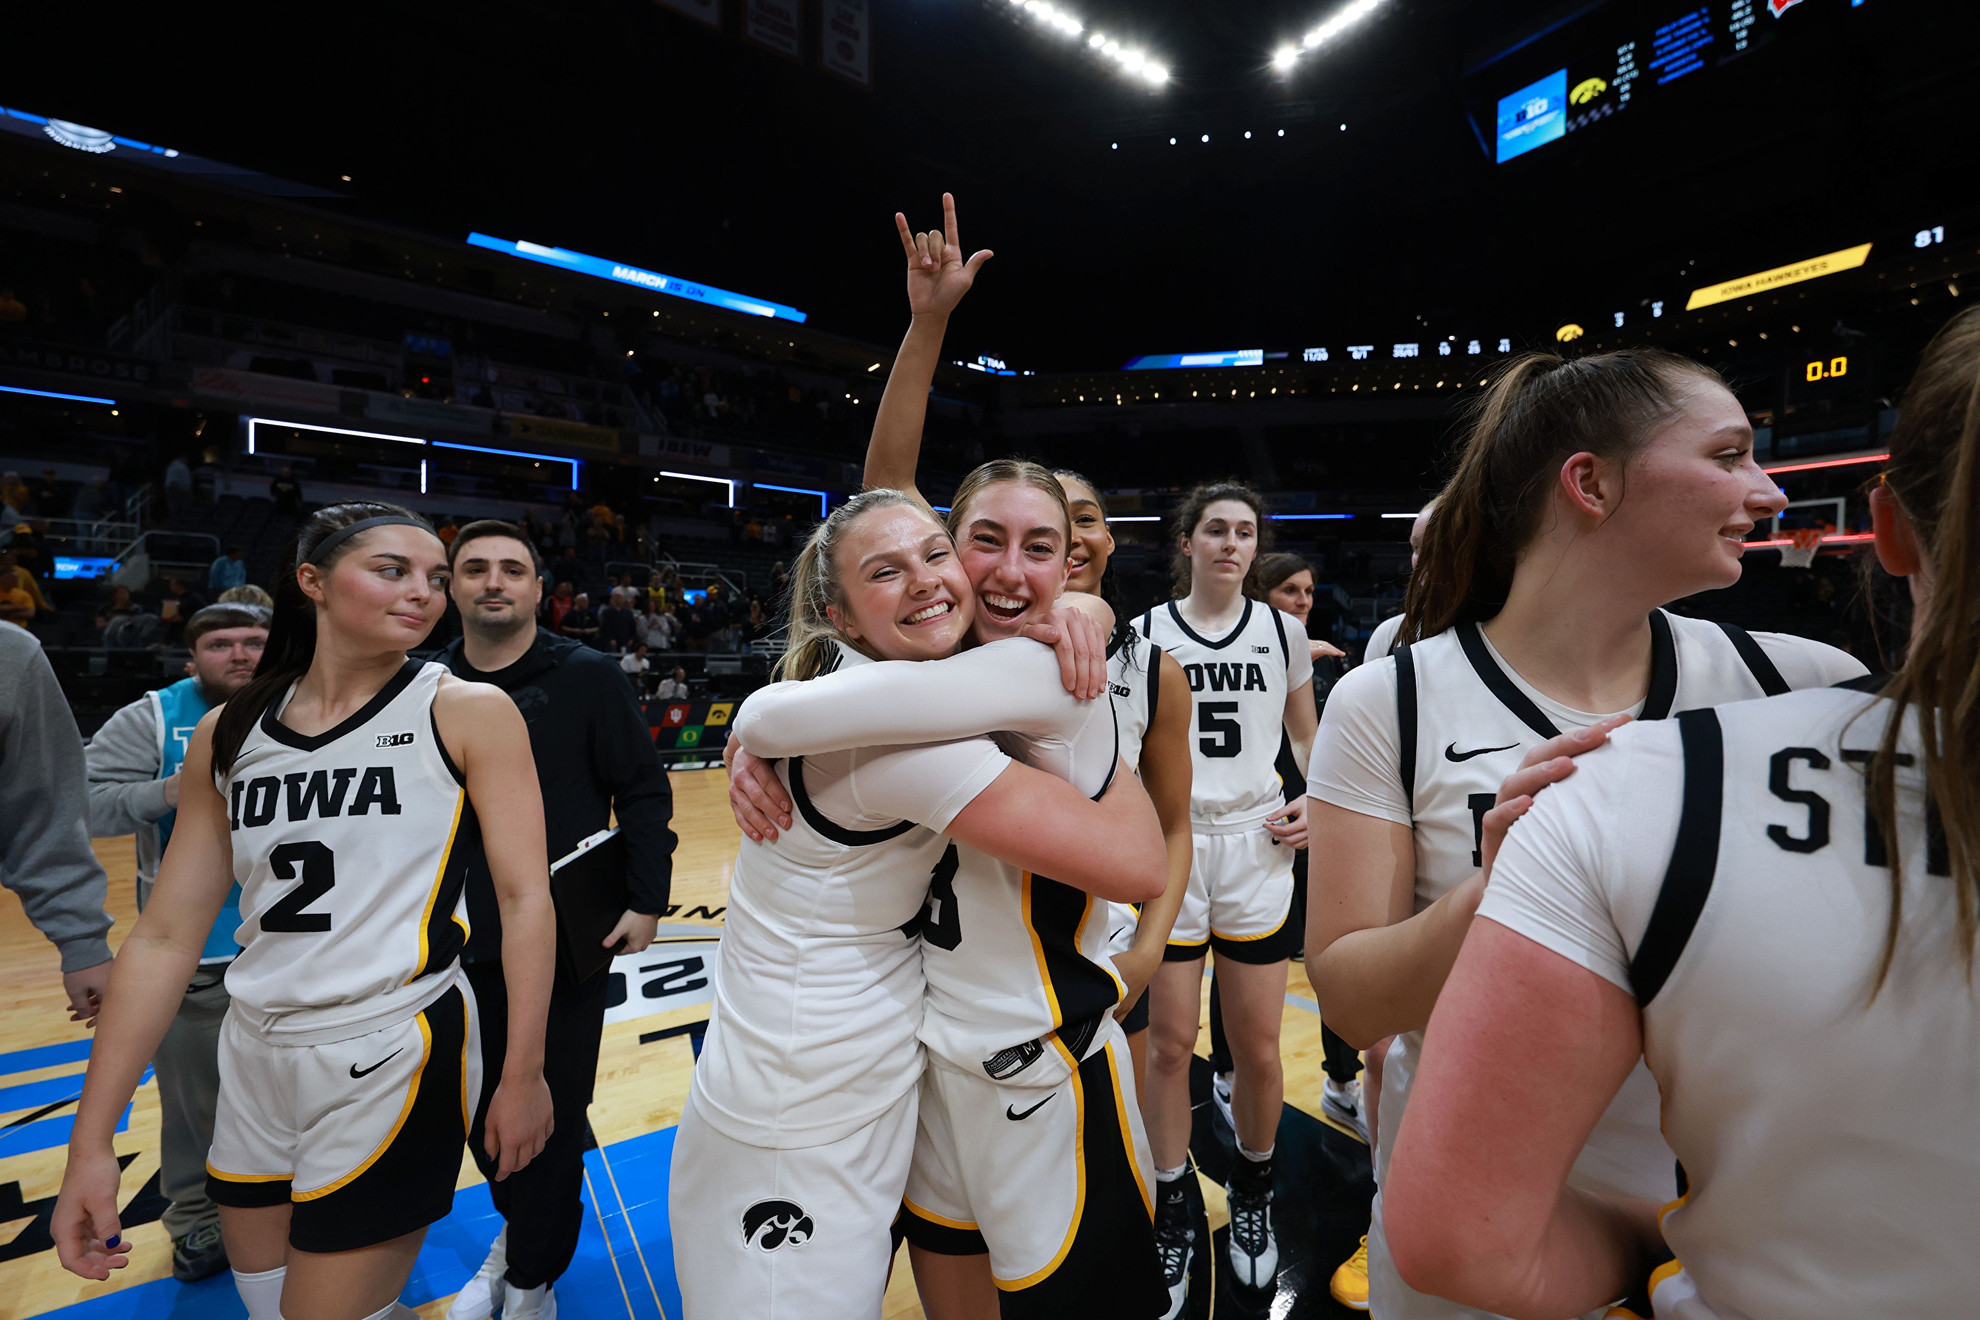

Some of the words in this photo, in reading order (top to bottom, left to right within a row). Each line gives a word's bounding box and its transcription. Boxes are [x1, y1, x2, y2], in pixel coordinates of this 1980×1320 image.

[1914, 225, 1945, 248] 81
[612, 265, 668, 289] MARCH
[669, 282, 683, 292] IS
[686, 286, 706, 297] ON
[1720, 281, 1752, 298] IOWA
[1755, 260, 1829, 288] HAWKEYES
[1806, 356, 1848, 382] 0.0
[658, 439, 712, 457] IBEW
[1183, 663, 1267, 692] OWA
[1198, 701, 1242, 758] 5
[231, 766, 402, 831] IOWA
[260, 840, 335, 932] 2
